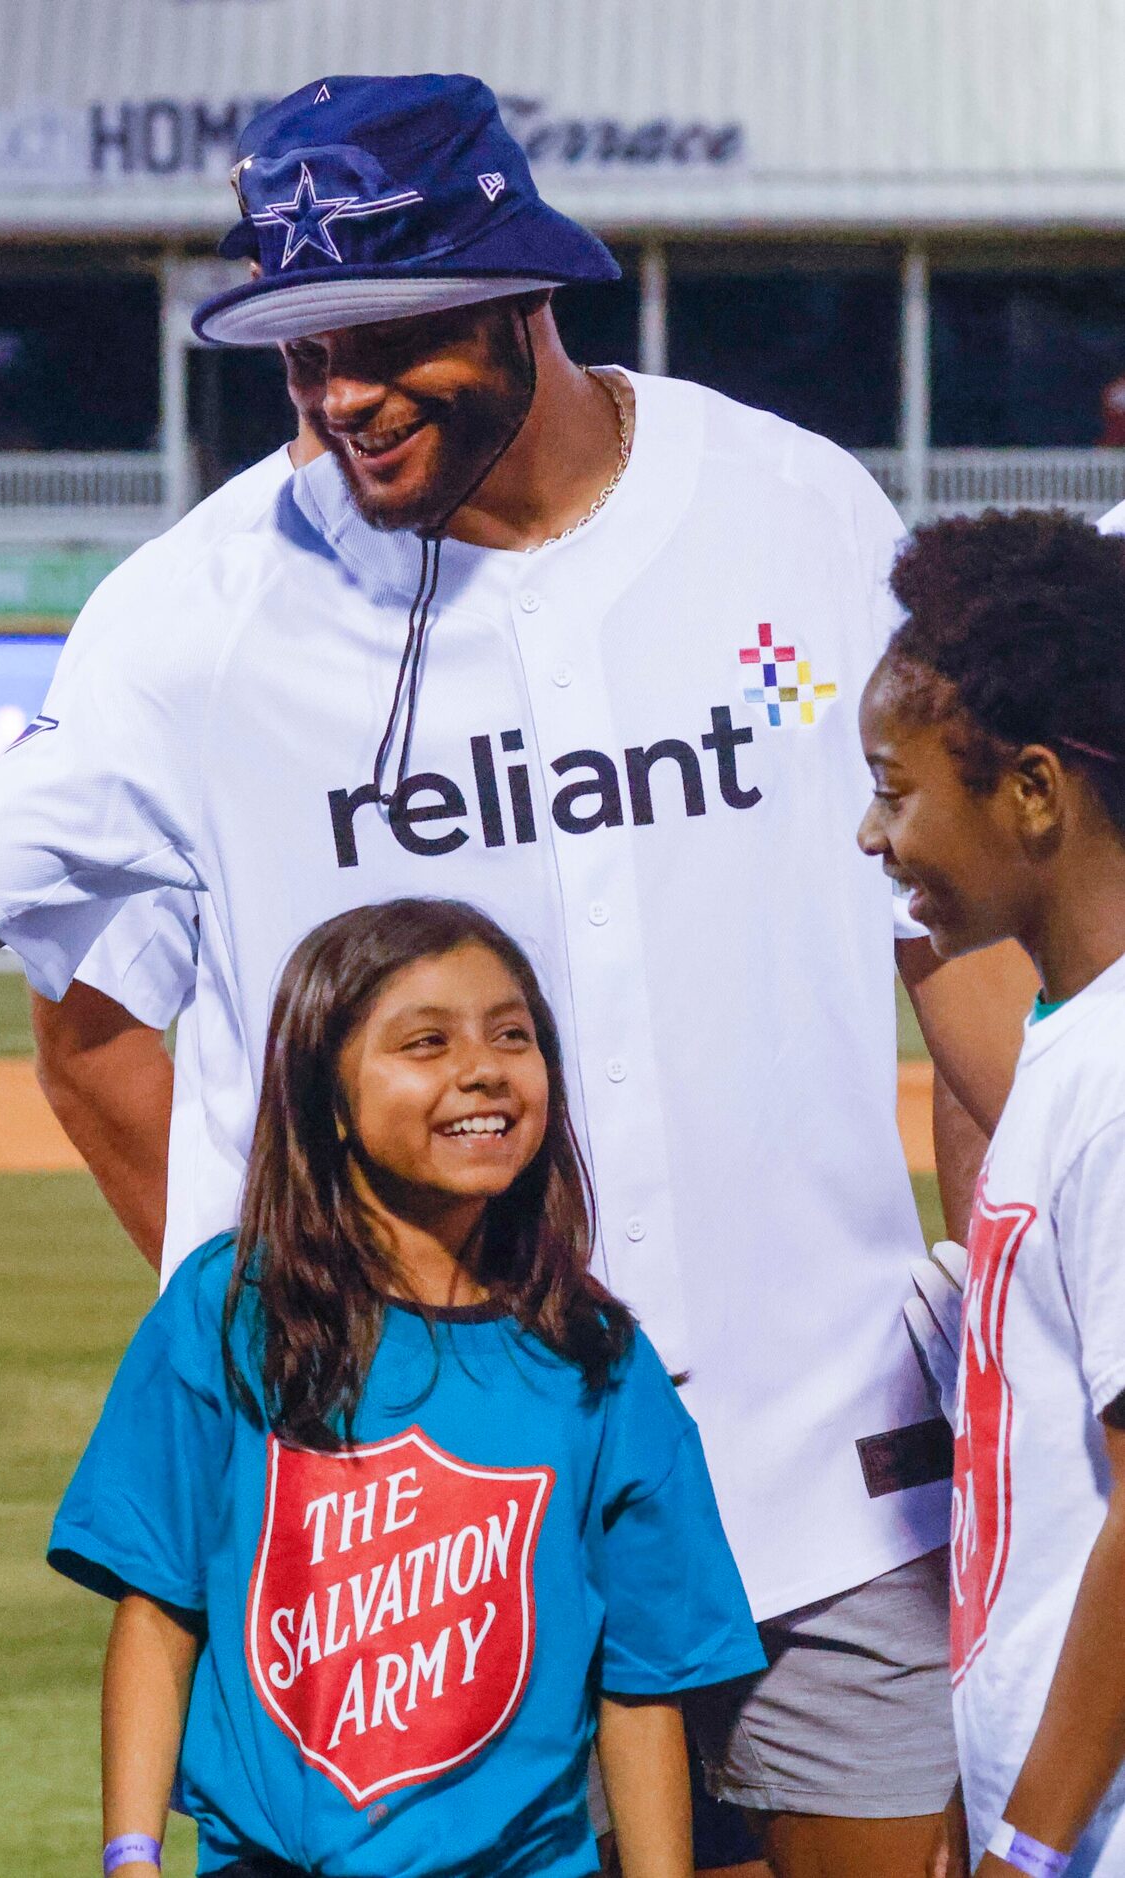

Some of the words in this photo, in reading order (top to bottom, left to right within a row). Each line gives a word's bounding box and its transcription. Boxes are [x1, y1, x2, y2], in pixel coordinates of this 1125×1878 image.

[88, 98, 277, 175] HOM
[327, 705, 763, 868] reliant
[302, 1467, 424, 1567] THE
[268, 1499, 519, 1690] SALVATION
[327, 1601, 497, 1751] ARMY
